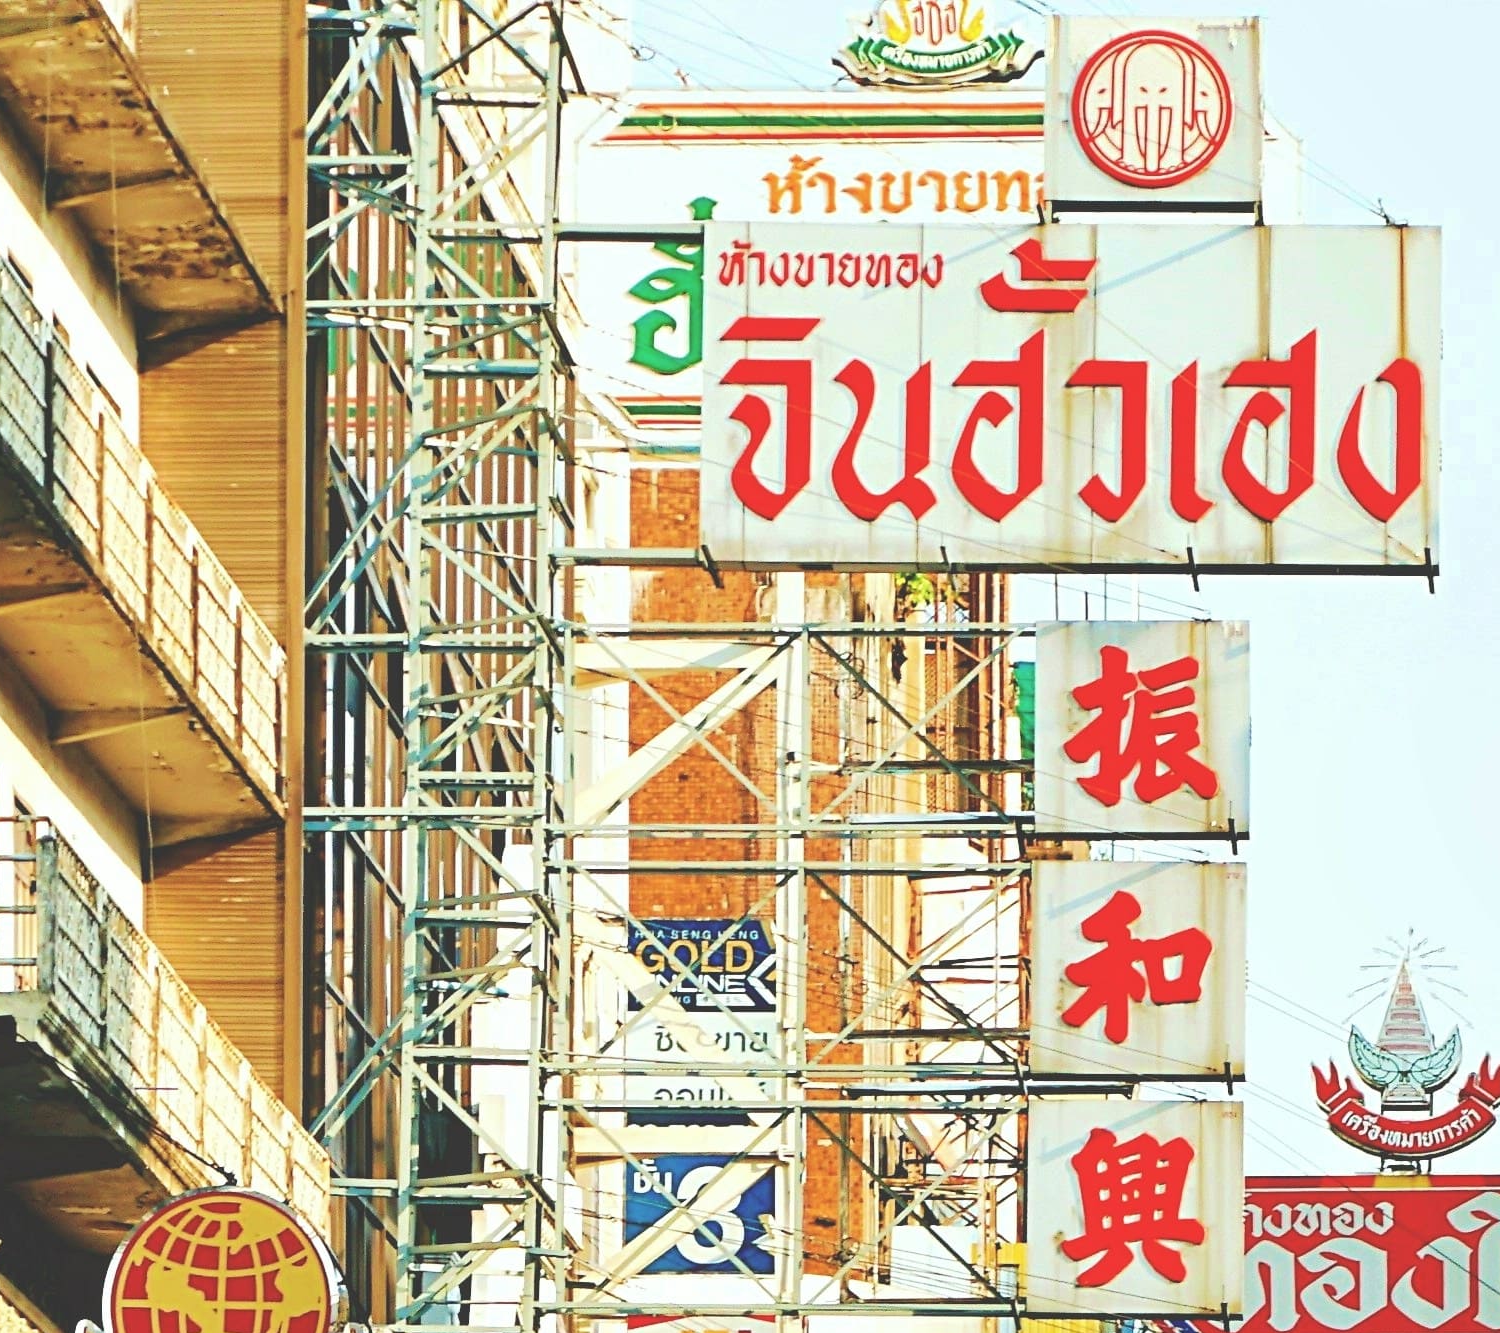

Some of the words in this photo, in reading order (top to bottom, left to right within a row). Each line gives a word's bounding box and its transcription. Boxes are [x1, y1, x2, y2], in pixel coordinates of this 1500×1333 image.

[716, 239, 945, 290] ห้างขายทอง
[717, 236, 1428, 523] จินฮั้วเฮง
[634, 939, 756, 974] GOLD
